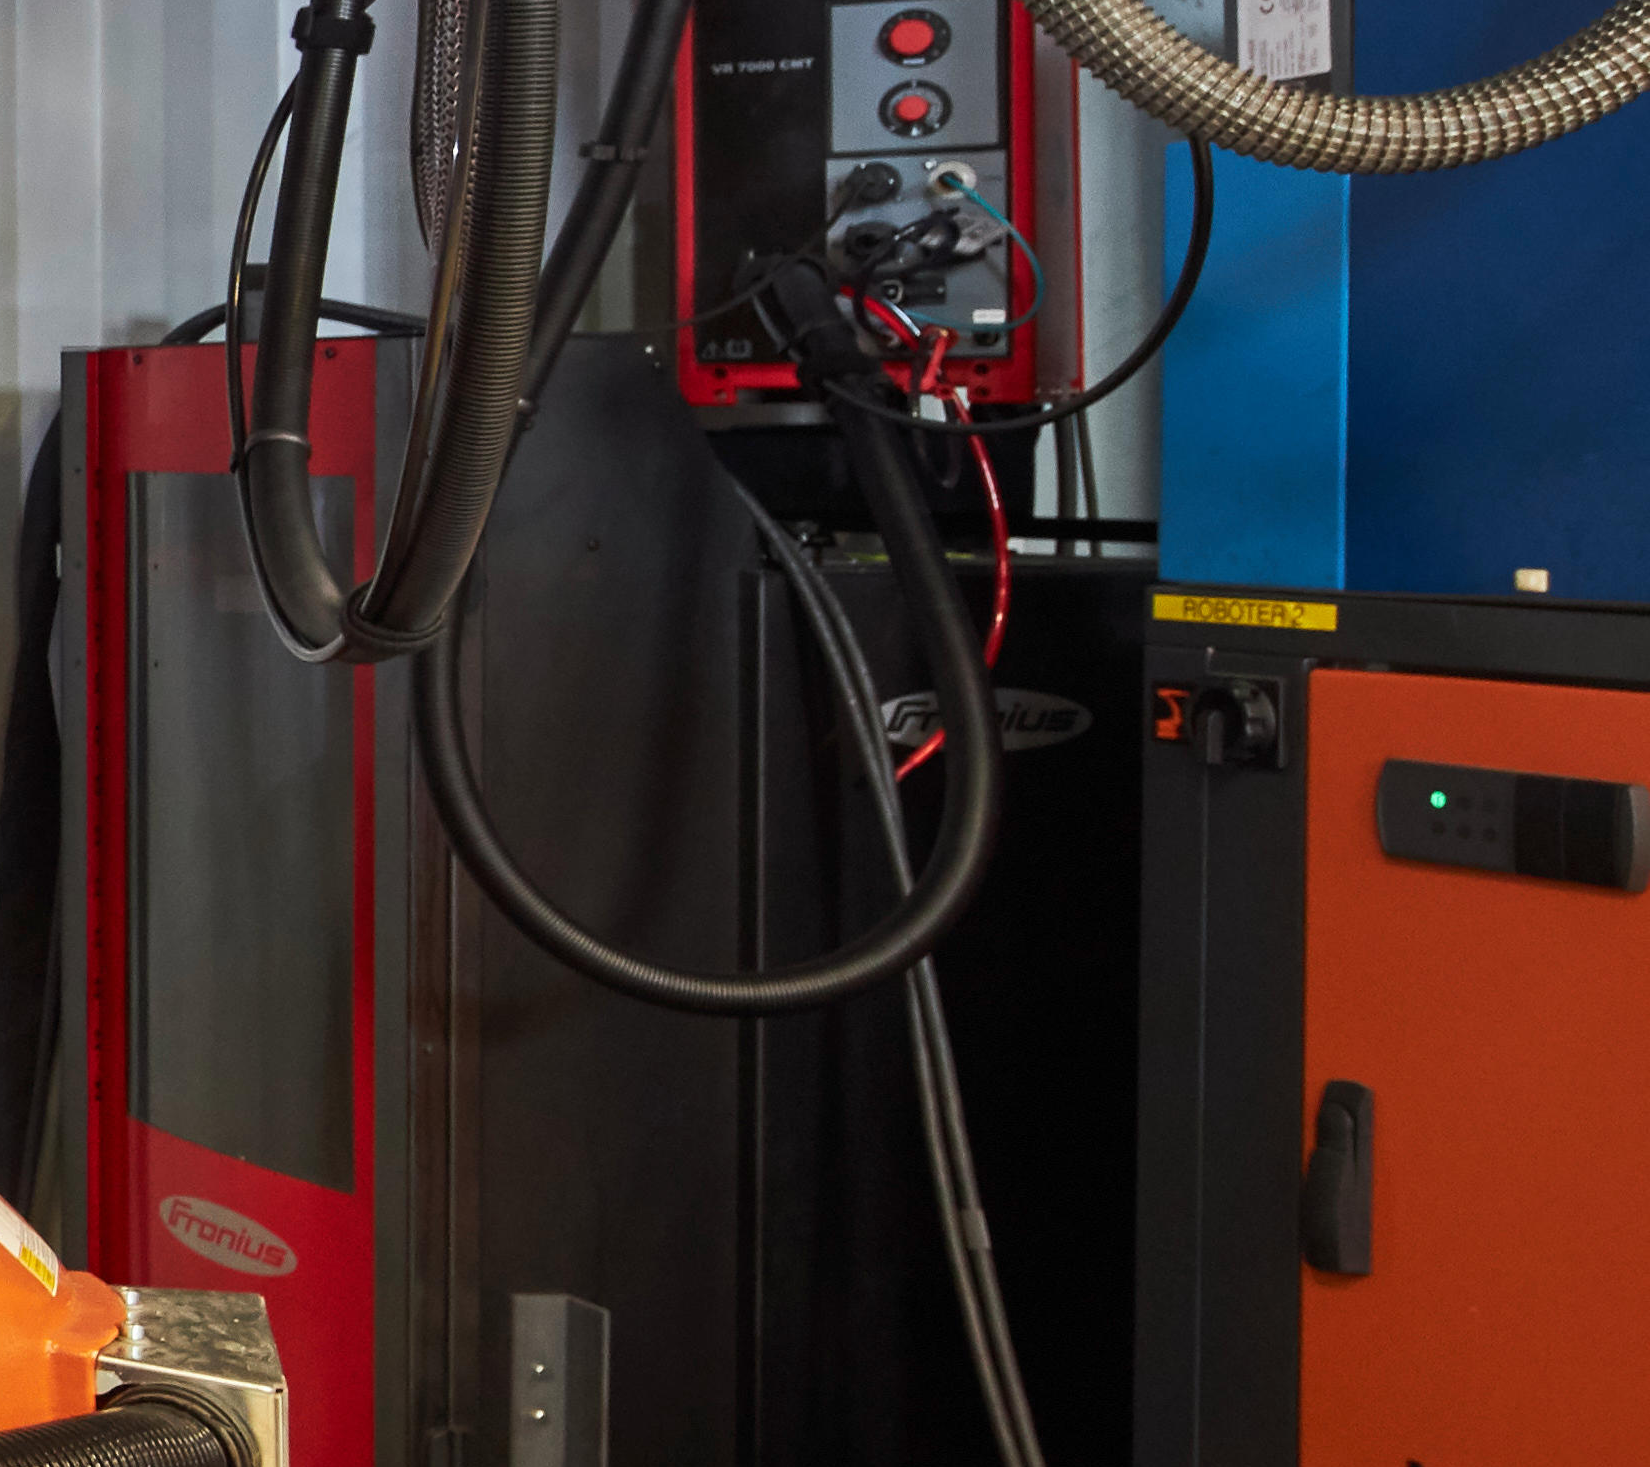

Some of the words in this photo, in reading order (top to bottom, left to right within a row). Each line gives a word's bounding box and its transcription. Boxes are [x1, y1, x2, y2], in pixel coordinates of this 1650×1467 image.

[779, 56, 816, 71] CMT
[1183, 599, 1286, 625] ROBOTER
[1290, 607, 1306, 627] 2
[166, 1197, 289, 1272] Fronius
